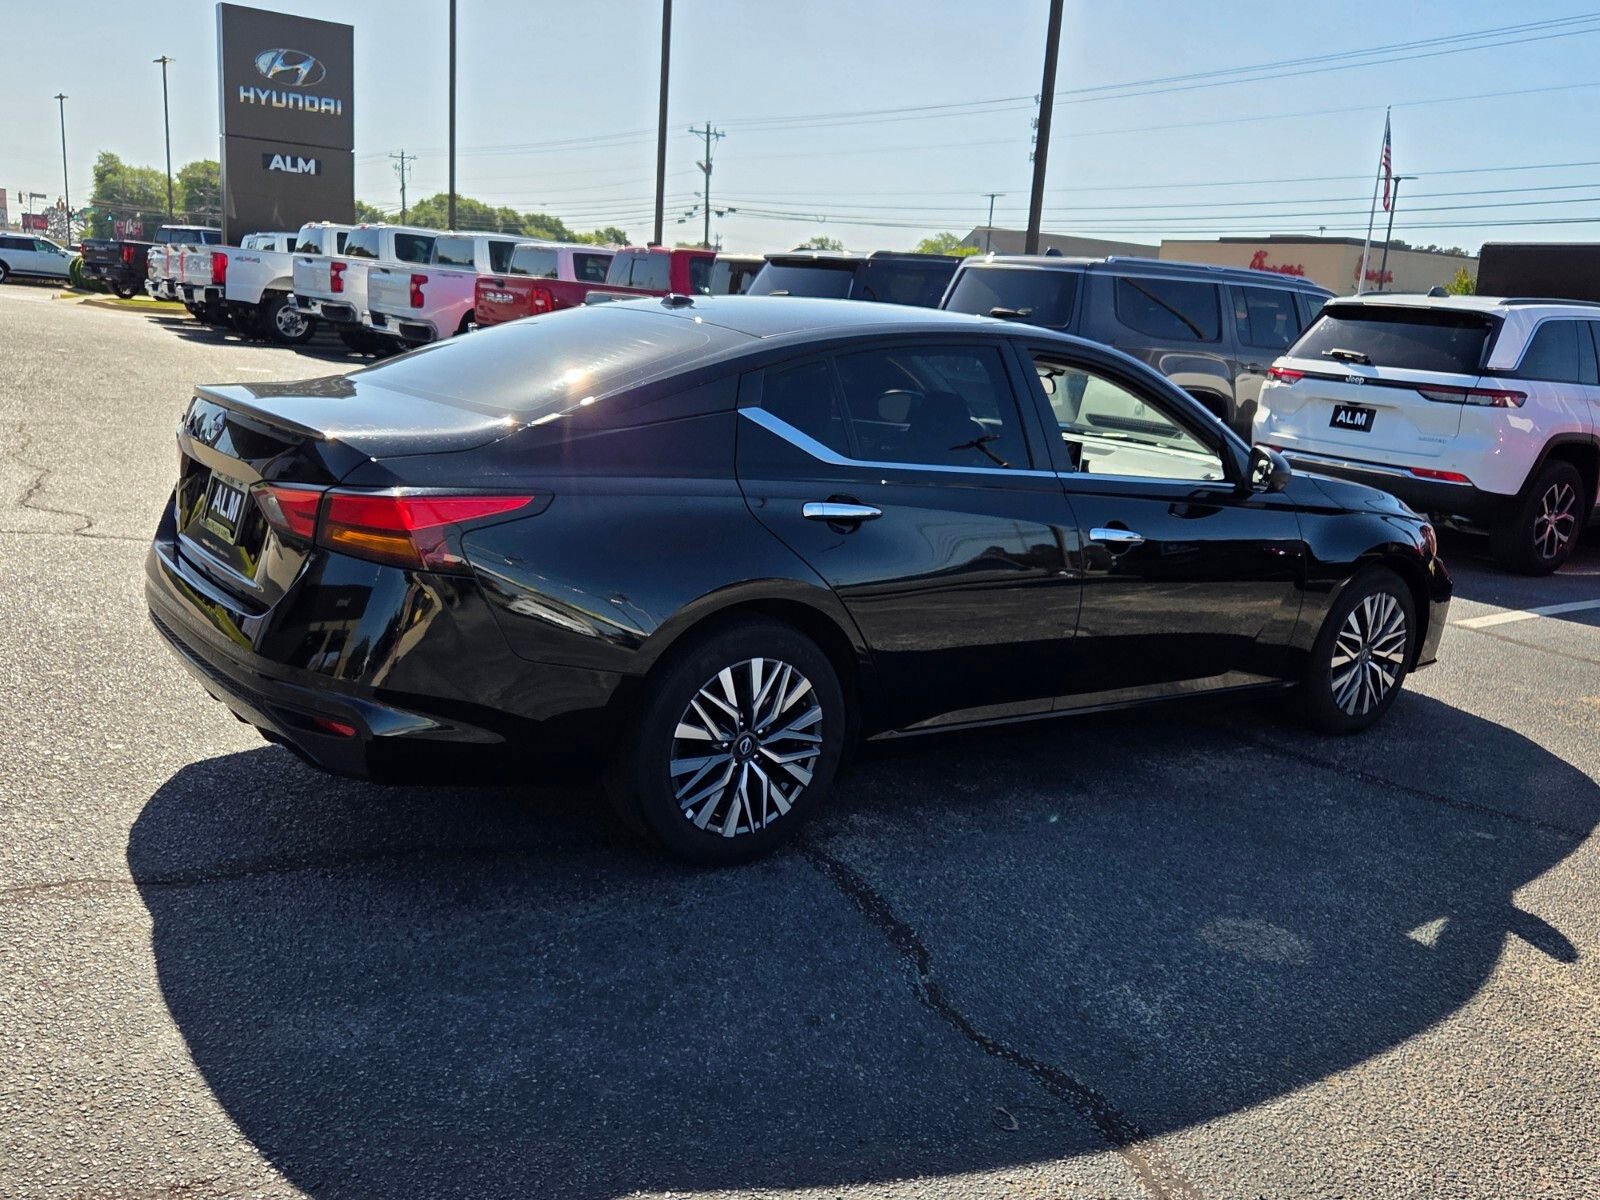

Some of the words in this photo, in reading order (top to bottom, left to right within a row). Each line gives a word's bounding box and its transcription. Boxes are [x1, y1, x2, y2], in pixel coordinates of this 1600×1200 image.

[239, 85, 342, 116] HYUNDAI
[268, 153, 316, 175] ALM
[1345, 374, 1365, 386] Jeep
[1336, 410, 1368, 426] ALM
[211, 484, 242, 523] ALM
